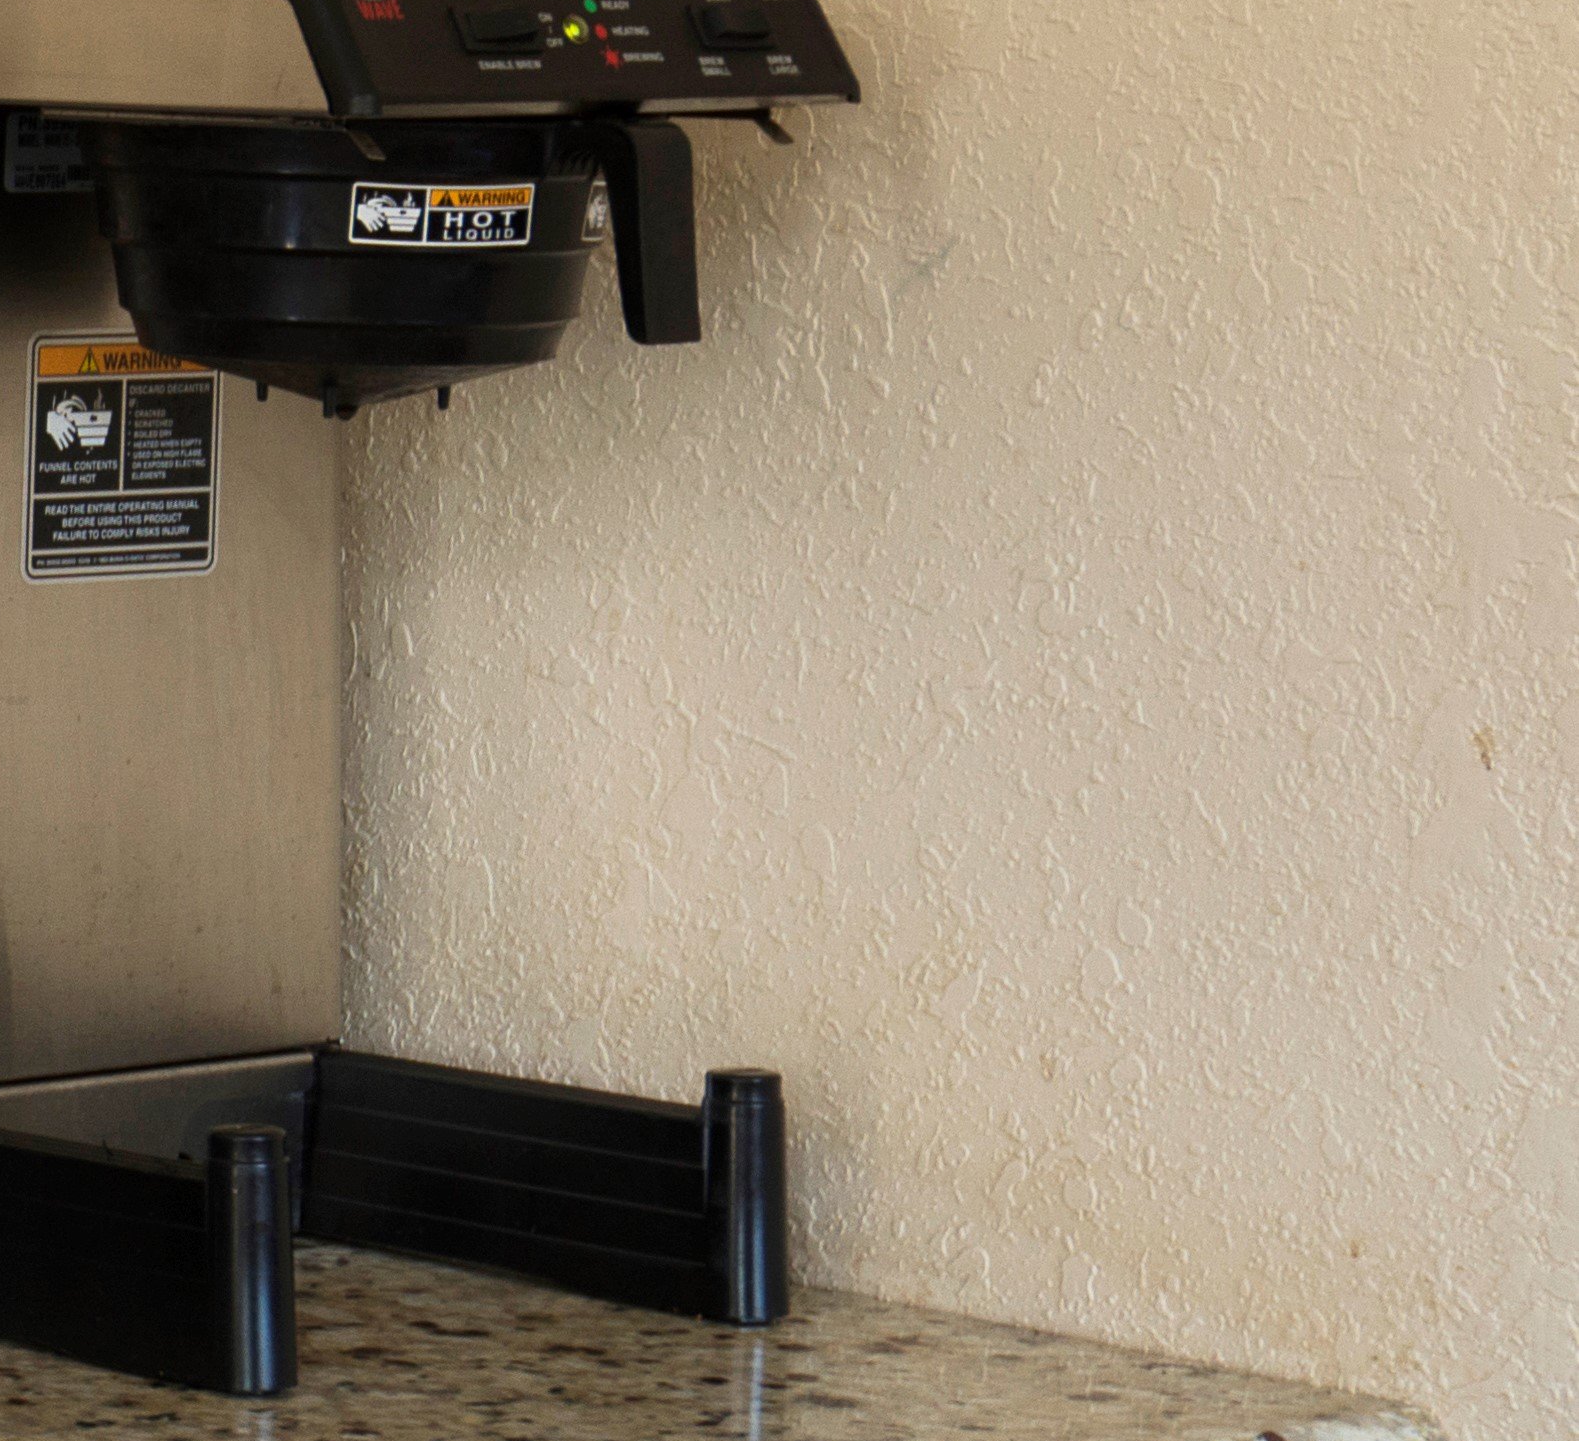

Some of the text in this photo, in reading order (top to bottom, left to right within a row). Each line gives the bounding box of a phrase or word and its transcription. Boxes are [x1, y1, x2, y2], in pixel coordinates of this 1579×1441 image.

[601, 0, 630, 10] READY
[612, 26, 650, 36] HEATING
[458, 190, 525, 205] WARNING
[445, 212, 516, 228] HOT
[443, 228, 514, 241] LIQUID
[129, 382, 210, 394] DISCARD DECANTER
[40, 460, 118, 472] FUNNEL CONTENTS
[60, 473, 96, 484] ARE HOT
[45, 500, 199, 515] READ THE ENTIRE OPERATING MANUAL
[62, 512, 182, 528] BEFORE USING THIS PRODUCT
[53, 526, 190, 542] FAILURE TO COMPLY RISKS INJURY
